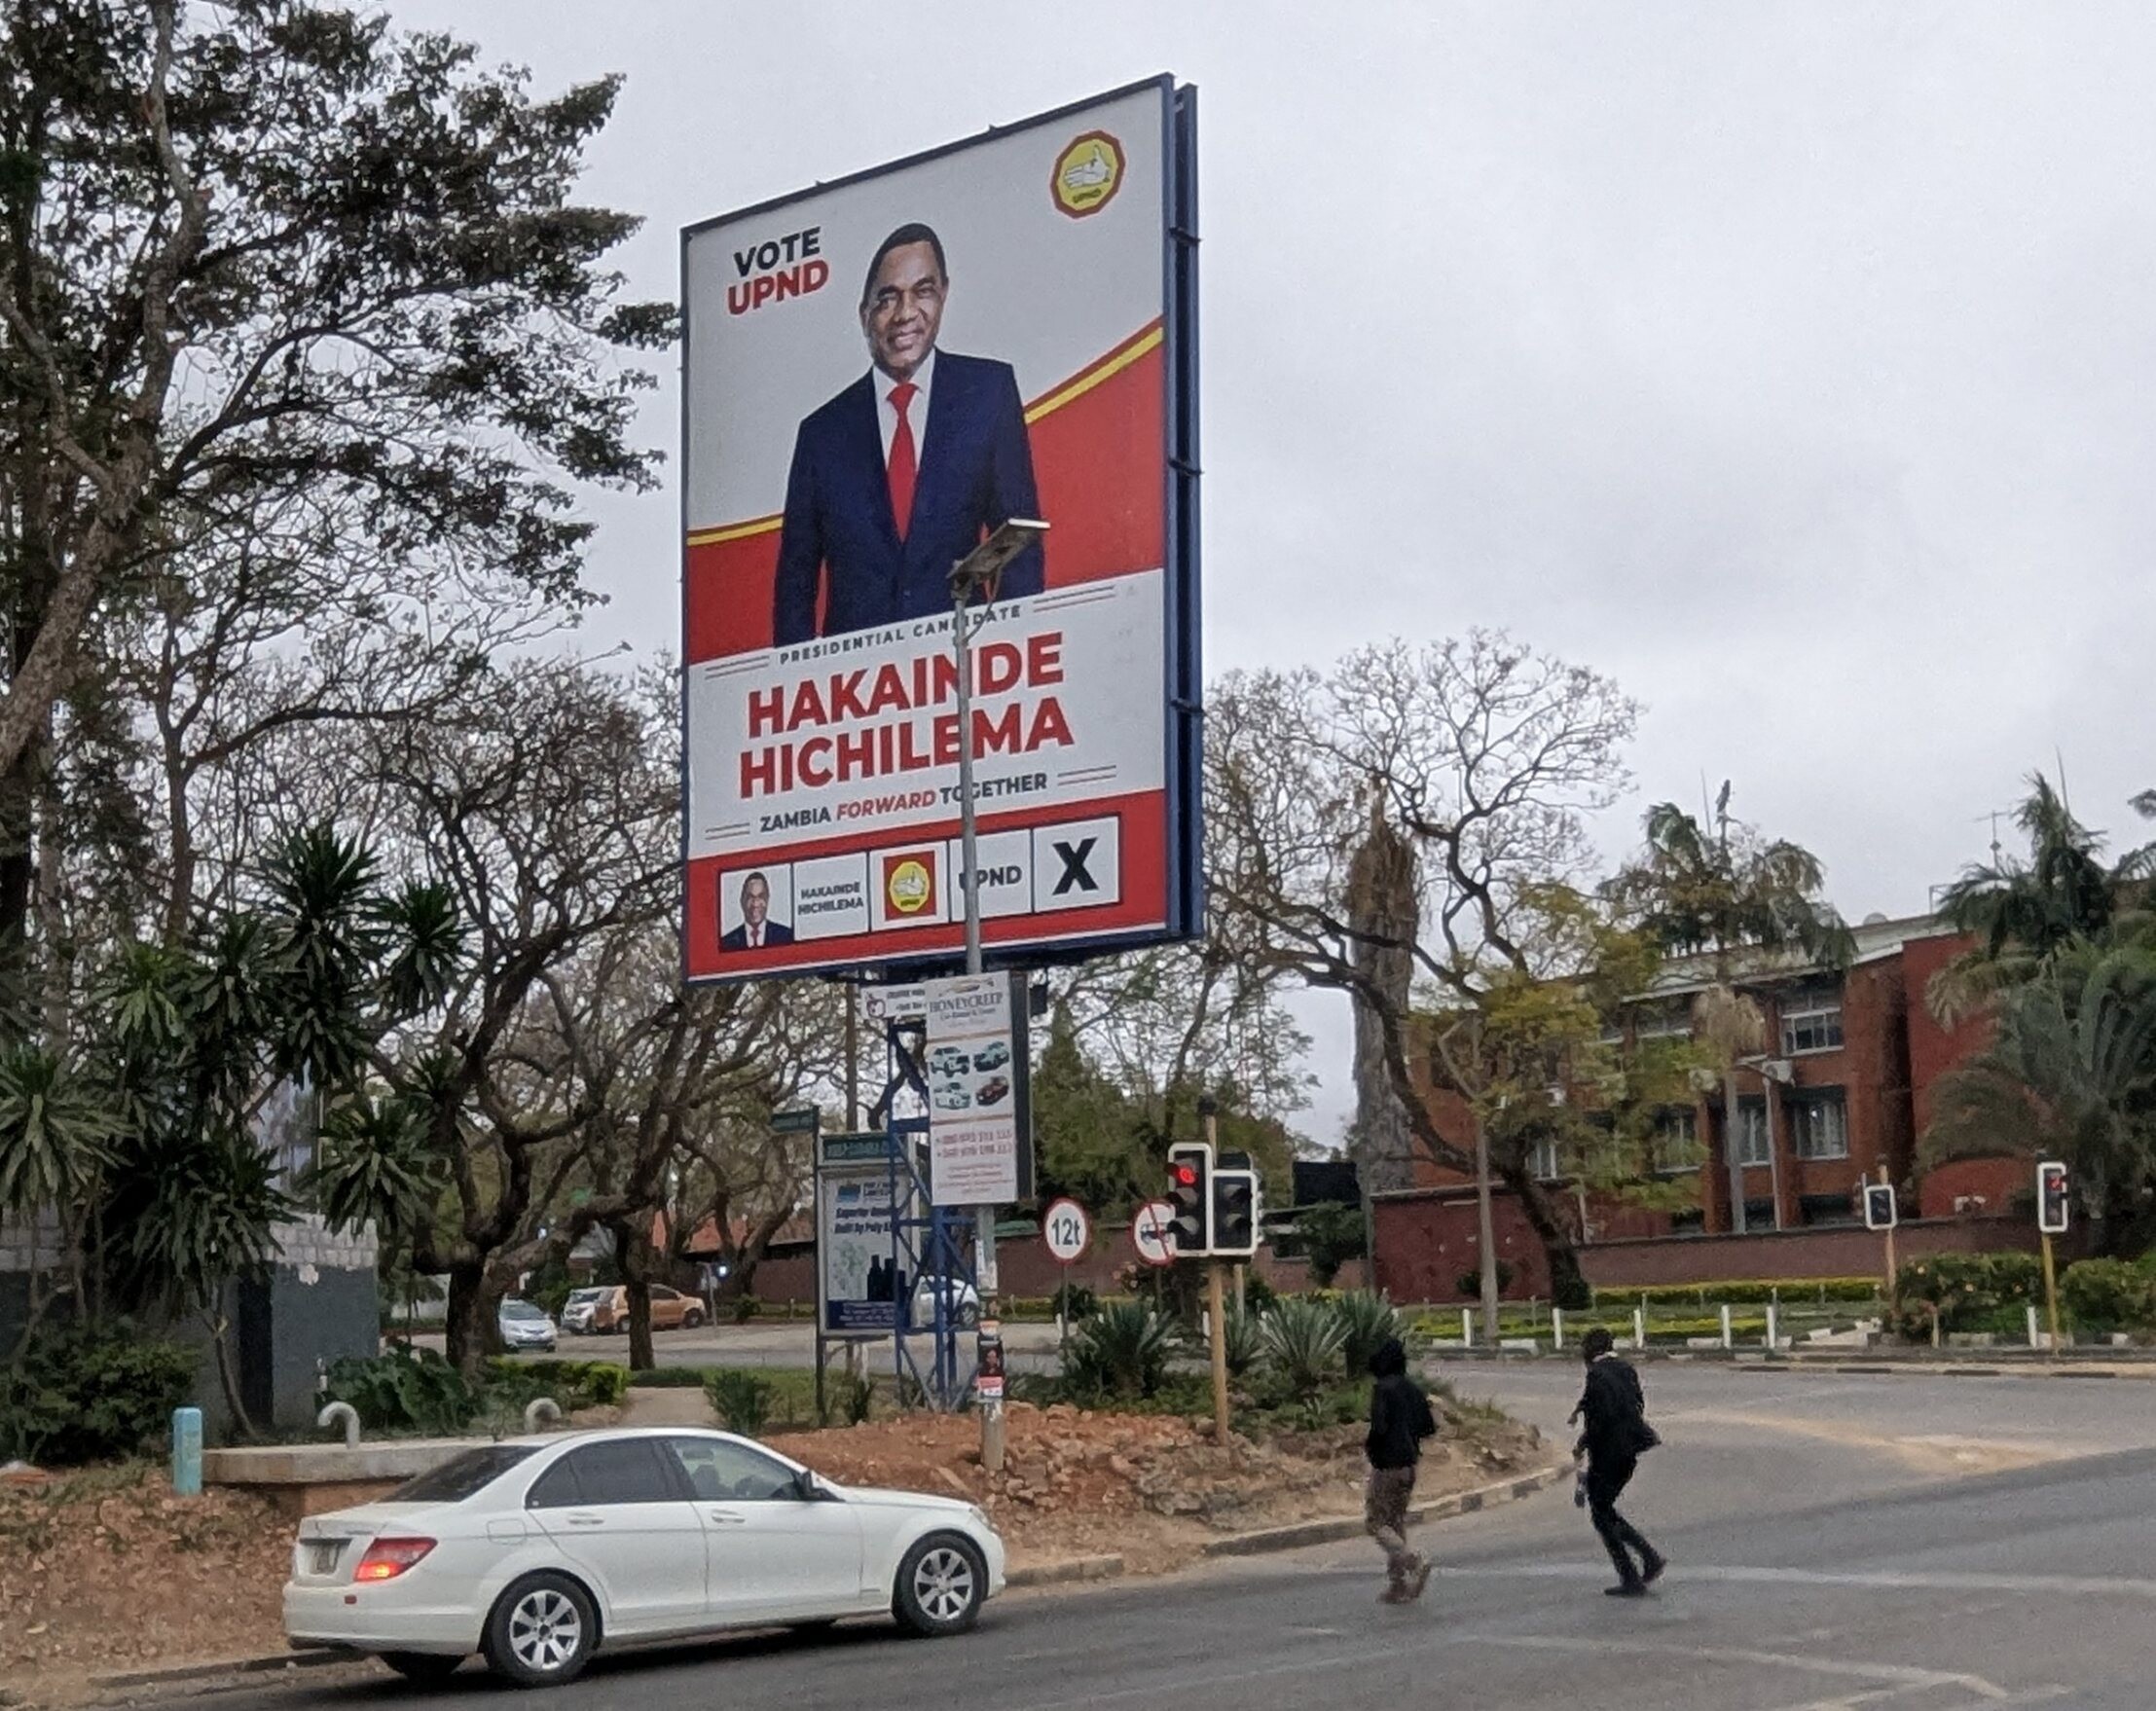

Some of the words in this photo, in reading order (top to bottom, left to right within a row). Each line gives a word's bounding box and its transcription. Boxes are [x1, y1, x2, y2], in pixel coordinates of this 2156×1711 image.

[733, 226, 822, 278] VOTE
[728, 260, 829, 315] UPND
[780, 628, 905, 665] PRESIDENTIAL
[749, 632, 1063, 739] HAKAINDE
[741, 696, 1075, 799] HICHILEMA
[760, 807, 831, 833] ZAMBIA
[836, 789, 936, 821] FORWARD
[1052, 836, 1100, 896] X
[797, 895, 864, 916] HICHILEMA
[800, 881, 861, 900] HAKAINDE
[1051, 1217, 1081, 1247] 12t
